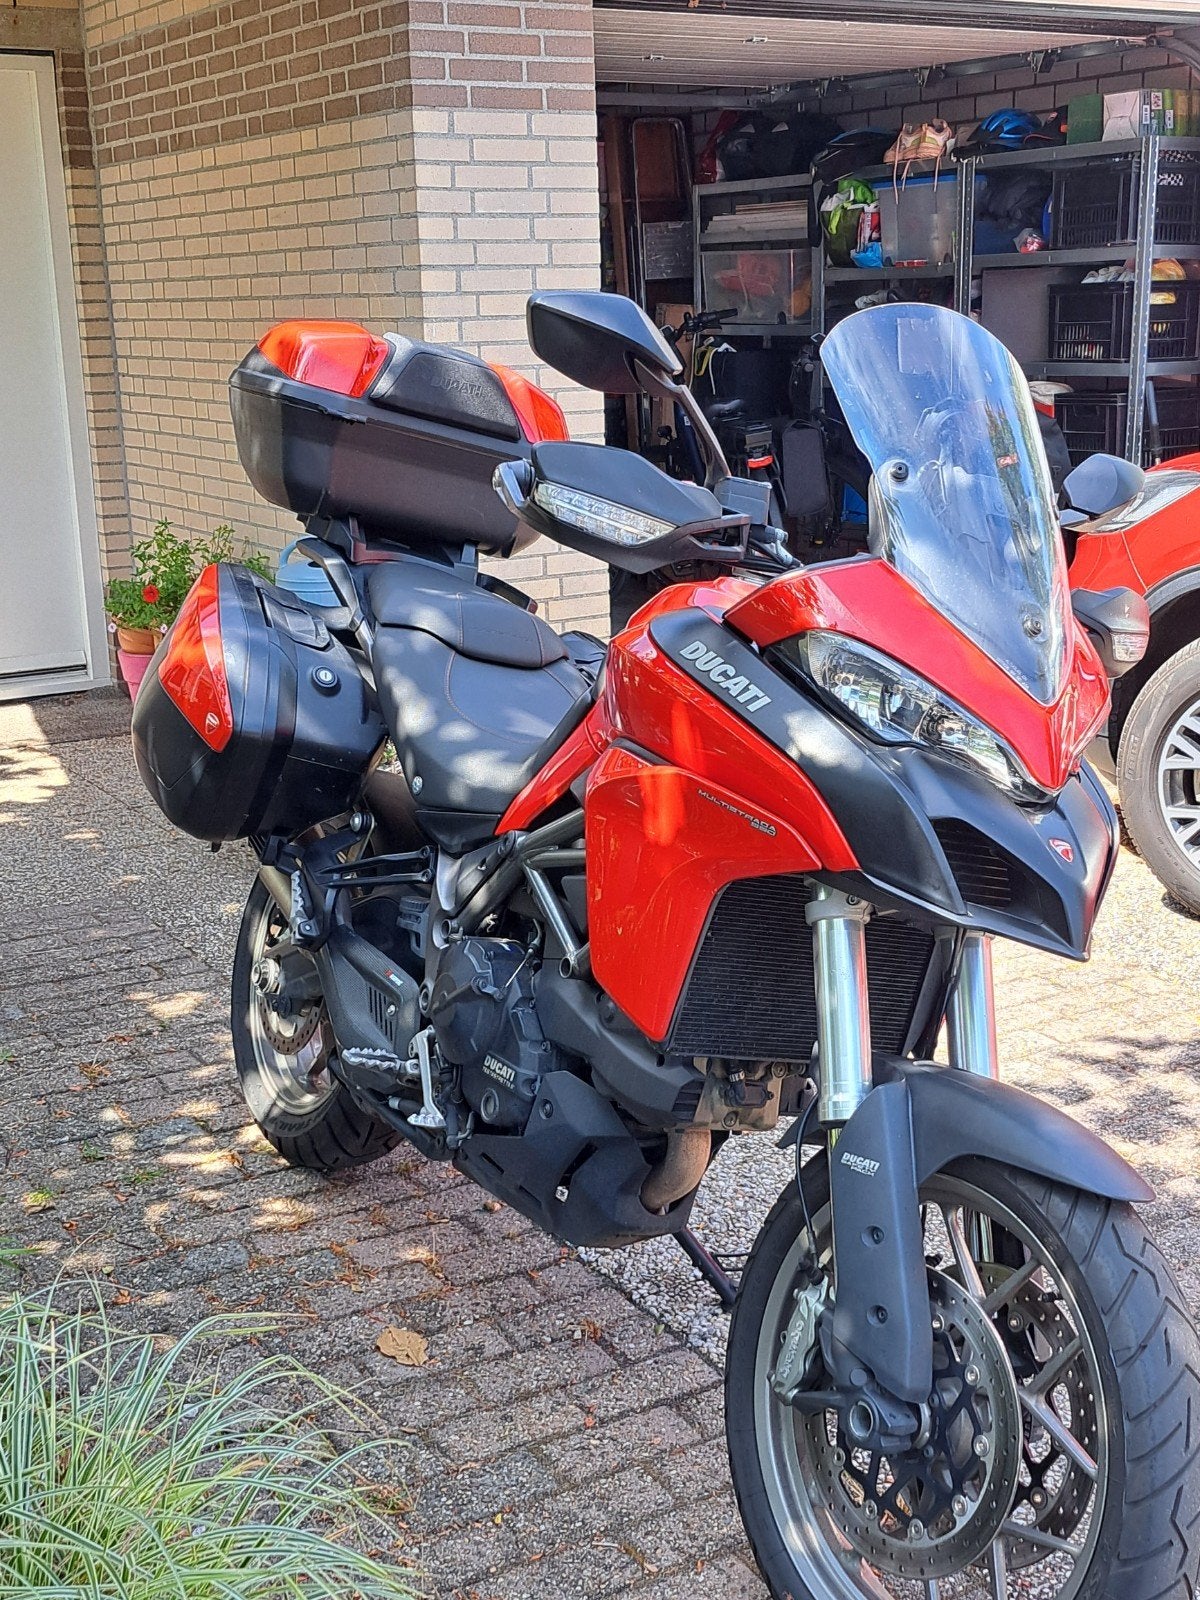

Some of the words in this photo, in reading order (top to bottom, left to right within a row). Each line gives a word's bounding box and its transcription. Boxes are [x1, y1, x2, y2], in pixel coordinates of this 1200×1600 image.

[679, 640, 772, 713] DUCATI
[698, 789, 776, 832] MULTISTRADA
[483, 1054, 515, 1082] DUCATI
[842, 1152, 880, 1171] DUCATI
